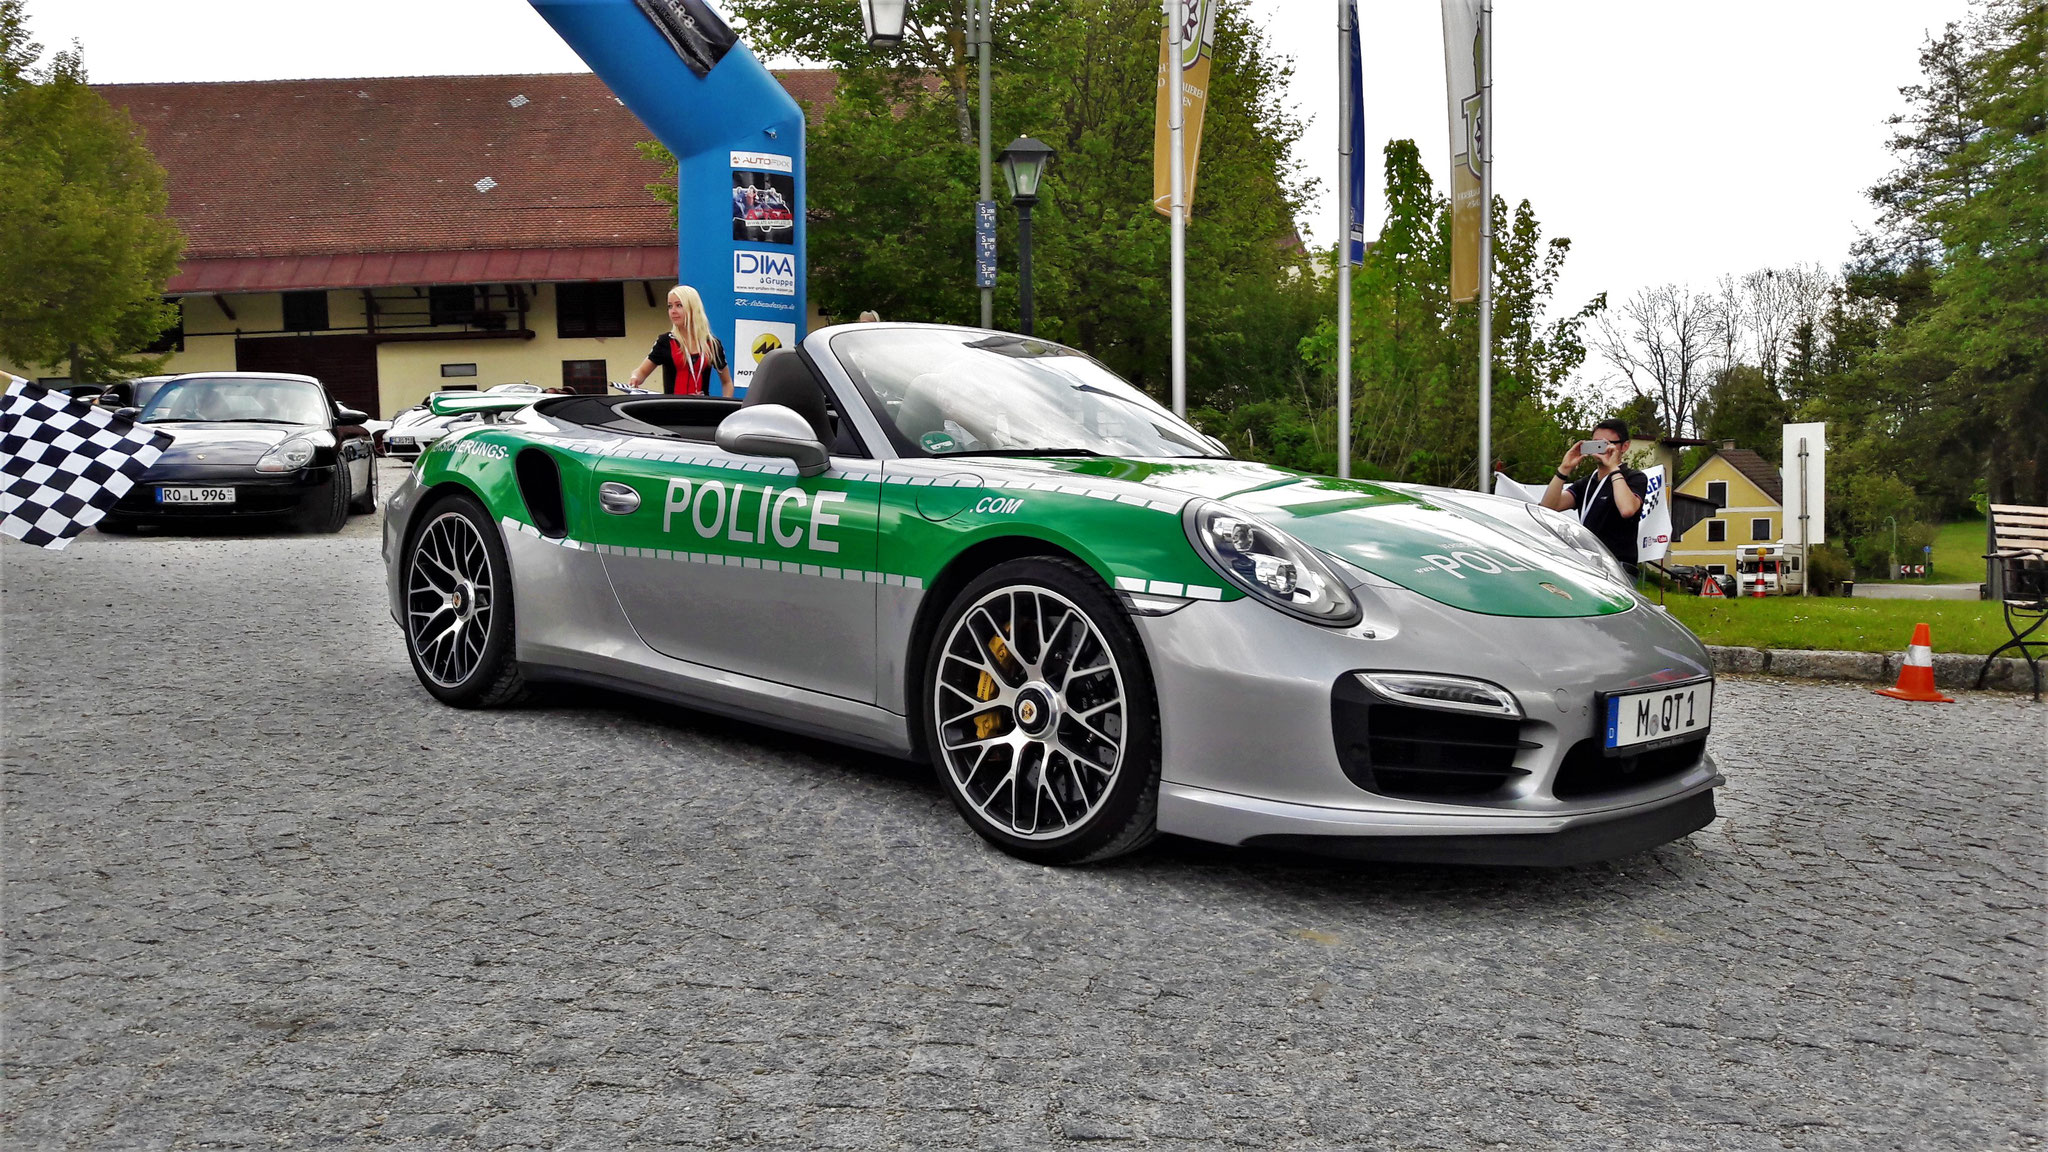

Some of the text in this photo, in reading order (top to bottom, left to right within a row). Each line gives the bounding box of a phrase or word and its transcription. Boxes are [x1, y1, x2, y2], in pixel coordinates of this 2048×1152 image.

[664, 0, 687, 17] ER
[765, 277, 793, 288] Gruppe
[163, 489, 226, 501] RO L 996
[968, 496, 1025, 515] .COM
[663, 477, 848, 553] POLICE
[1637, 698, 1650, 737] M
